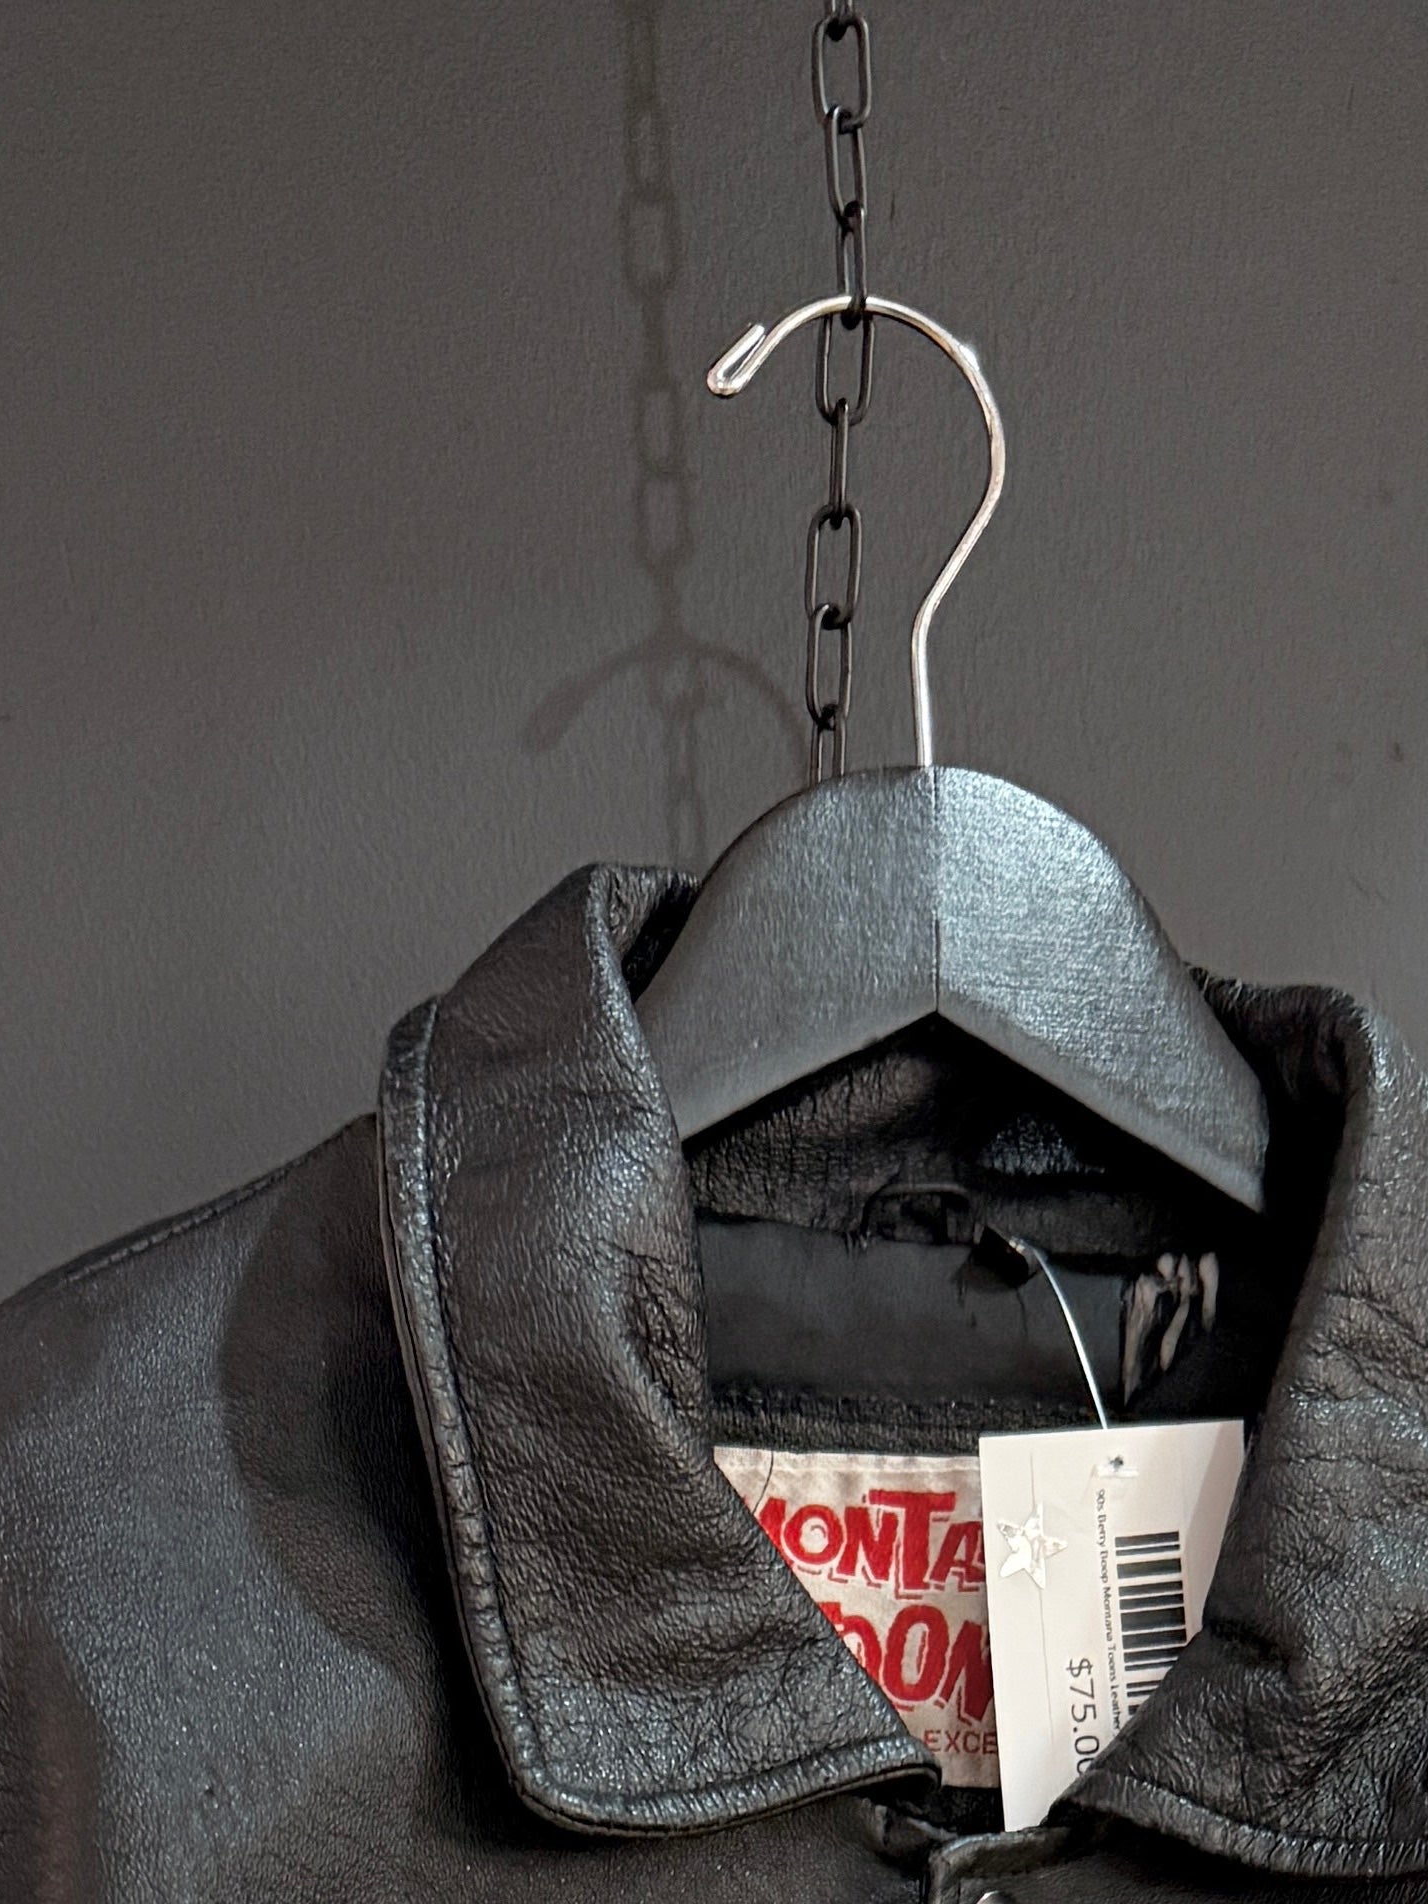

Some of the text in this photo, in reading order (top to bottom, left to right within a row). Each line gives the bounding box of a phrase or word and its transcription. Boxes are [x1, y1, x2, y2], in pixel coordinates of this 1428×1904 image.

[1102, 1586, 1114, 1642] Montana
[1107, 1644, 1118, 1682] Toons
[1109, 1684, 1121, 1730] Leather
